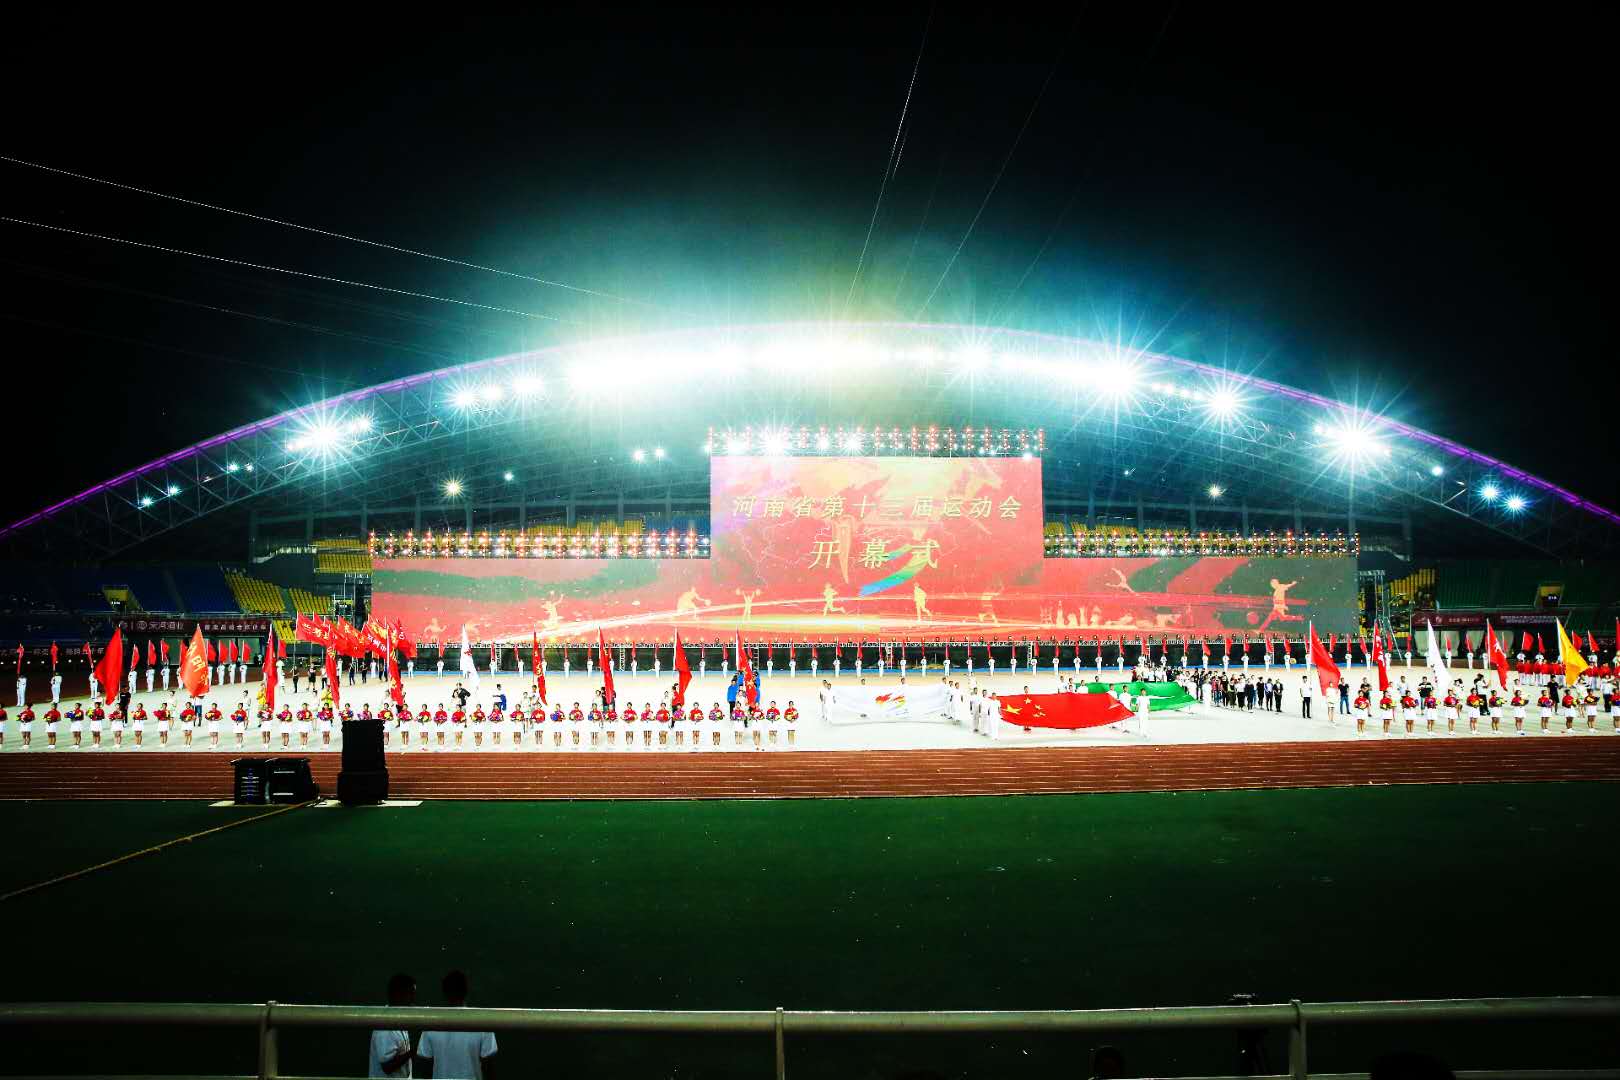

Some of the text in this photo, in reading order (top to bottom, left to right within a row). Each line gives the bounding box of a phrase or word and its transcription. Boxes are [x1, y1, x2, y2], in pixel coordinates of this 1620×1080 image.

[732, 495, 1022, 519] 河南省第十三届运动会
[808, 538, 940, 569] 开幕式
